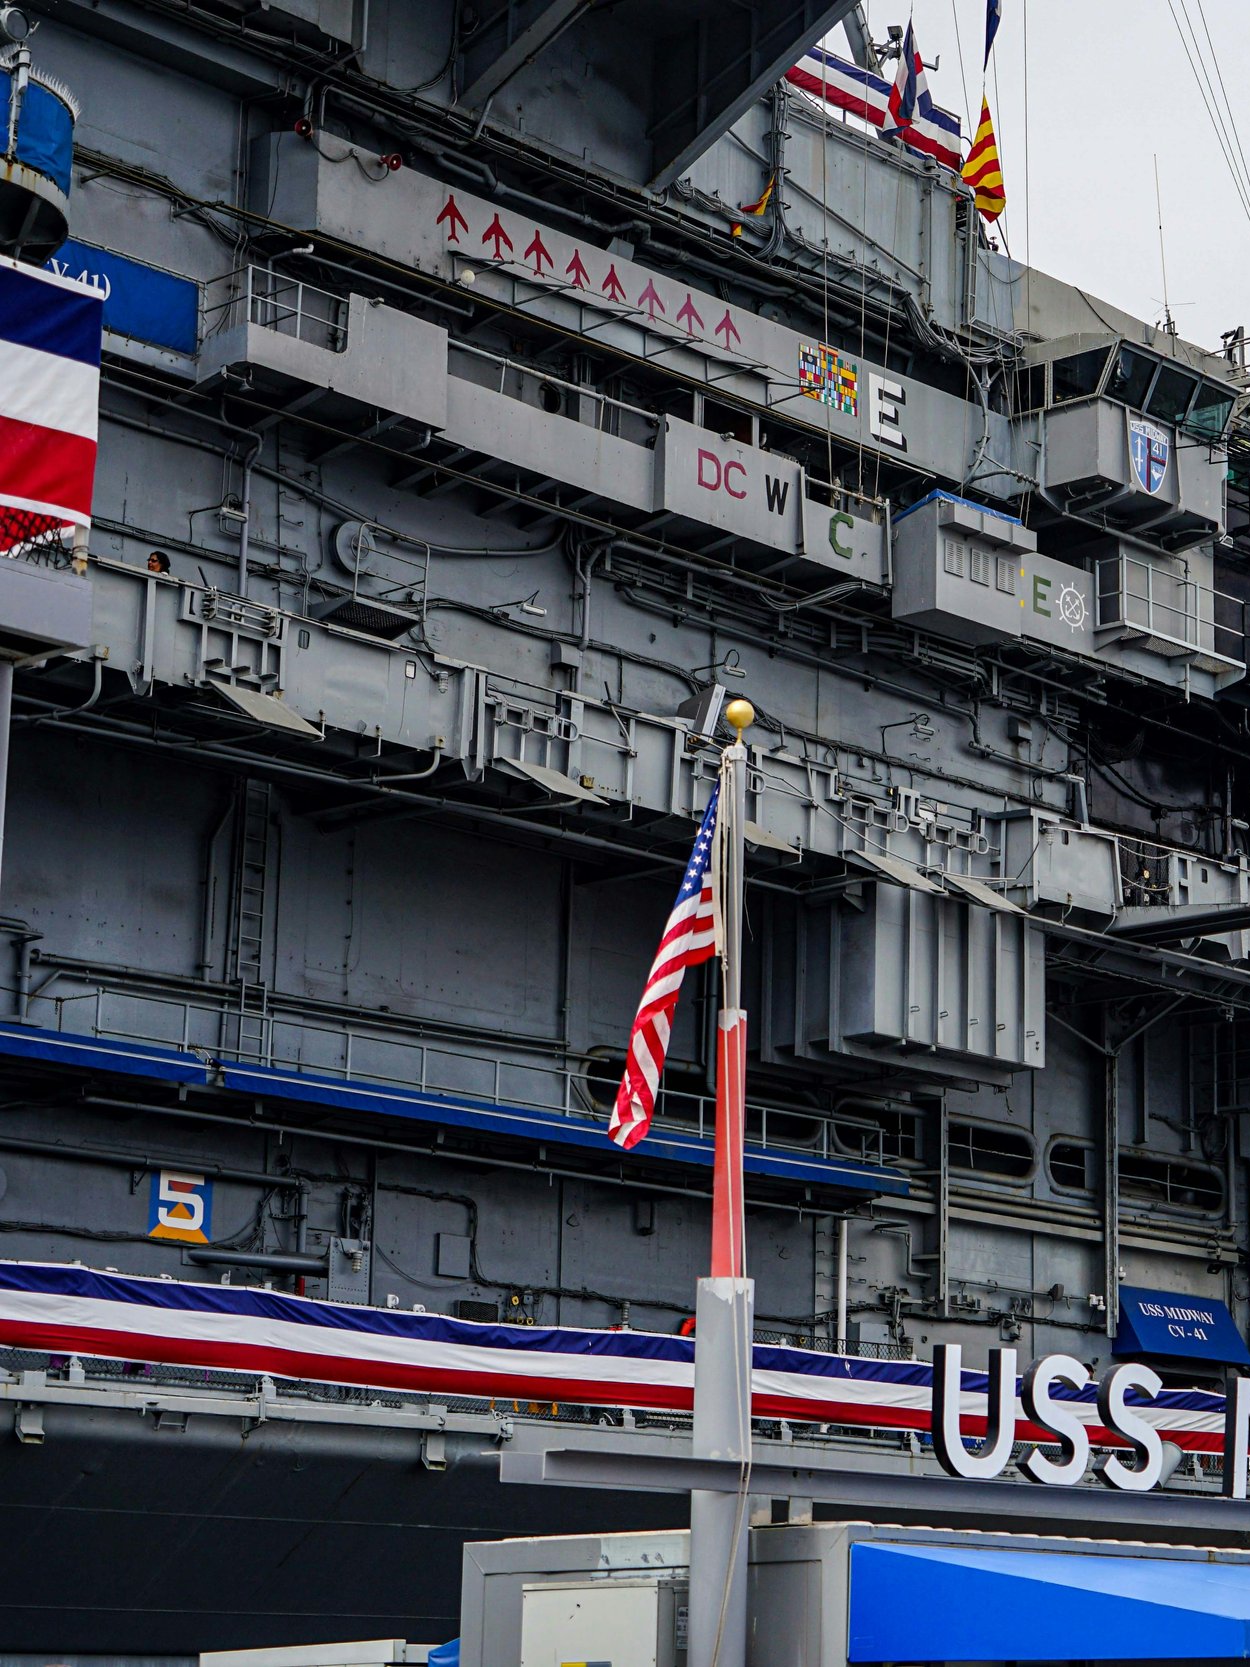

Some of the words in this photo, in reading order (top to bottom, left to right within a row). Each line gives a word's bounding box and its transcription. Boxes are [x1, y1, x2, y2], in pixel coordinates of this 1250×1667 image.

[868, 372, 907, 453] E
[1152, 442, 1164, 457] 41
[697, 447, 747, 500] DC
[765, 474, 789, 516] W
[829, 511, 854, 560] C
[1033, 574, 1051, 618] E
[158, 1169, 205, 1231] 5
[1138, 1302, 1165, 1318] USS
[1163, 1305, 1216, 1325] MIDWAY
[934, 1343, 1163, 1492] USS
